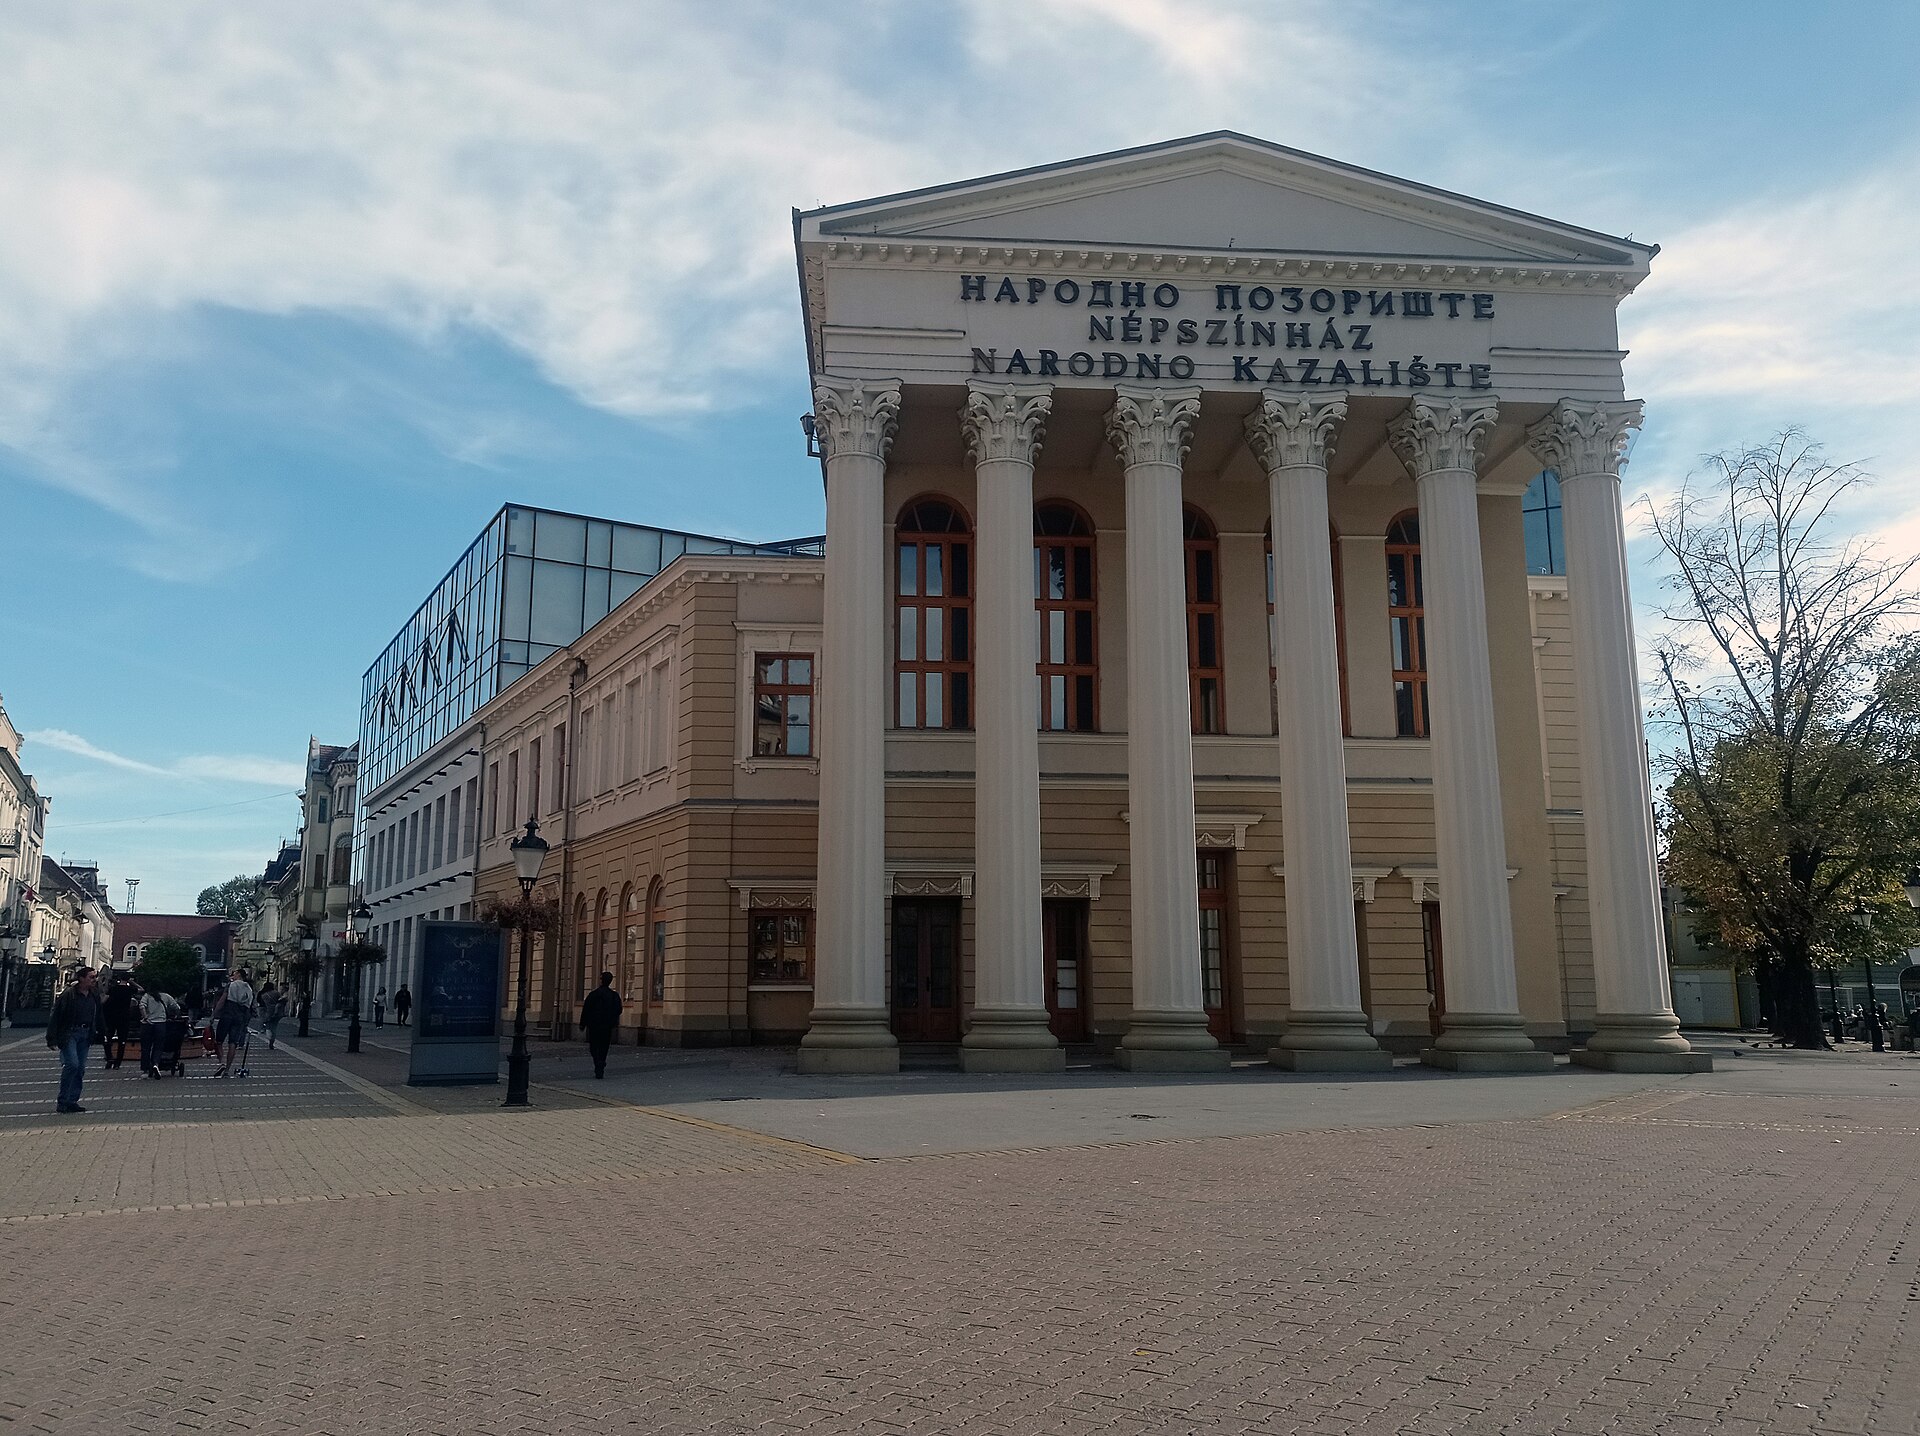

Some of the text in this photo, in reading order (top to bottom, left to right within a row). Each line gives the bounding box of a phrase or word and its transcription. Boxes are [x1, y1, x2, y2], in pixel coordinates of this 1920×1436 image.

[960, 274, 1495, 319] НАРОДНО ПОЗОРИШТЕ
[1088, 309, 1374, 350] NÉPSZÍNHÁZ
[971, 347, 1493, 389] NARODNO KAZALIŠTE
